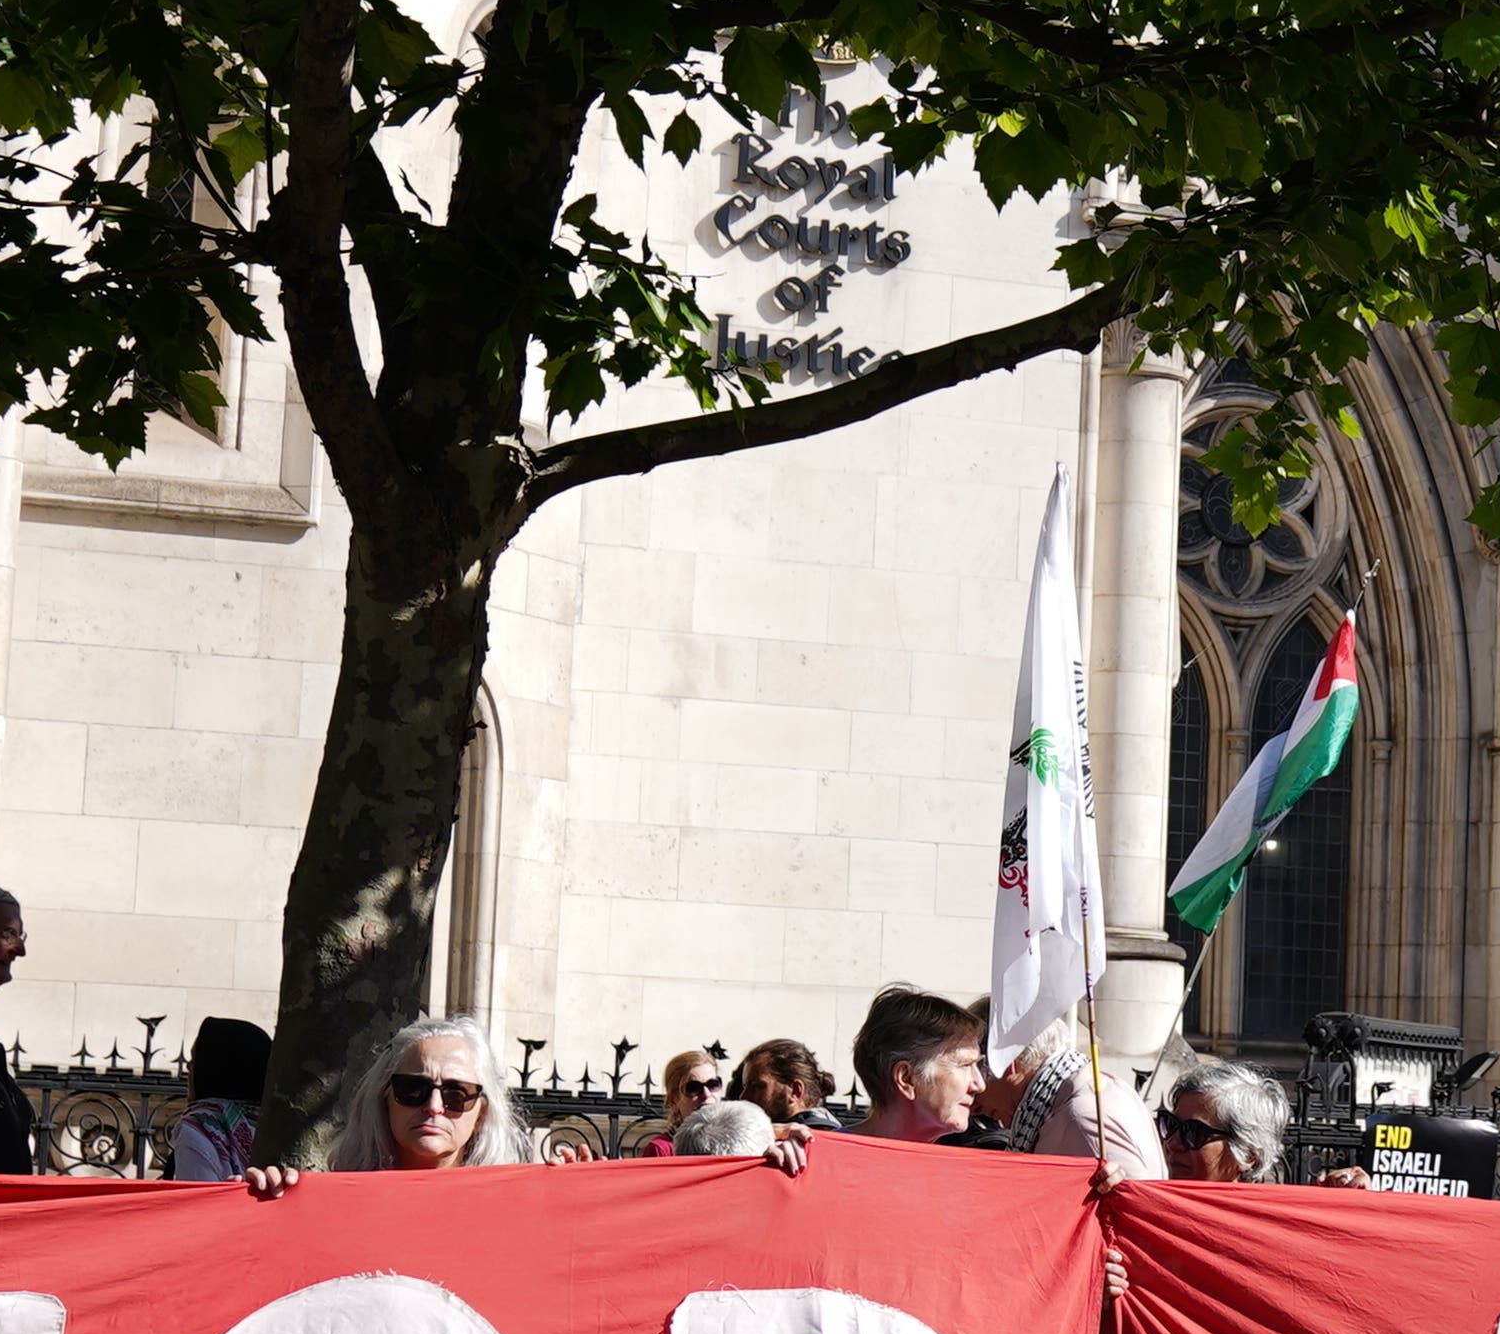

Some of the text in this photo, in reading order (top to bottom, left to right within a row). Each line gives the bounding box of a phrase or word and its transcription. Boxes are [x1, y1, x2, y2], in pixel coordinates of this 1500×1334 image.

[731, 132, 897, 205] Royal
[713, 195, 912, 264] Courts
[774, 264, 845, 314] of
[714, 313, 905, 378] Justic
[1375, 1124, 1412, 1150] END
[1370, 1173, 1469, 1198] APARTHEID
[1372, 1149, 1441, 1177] ISRAELI
